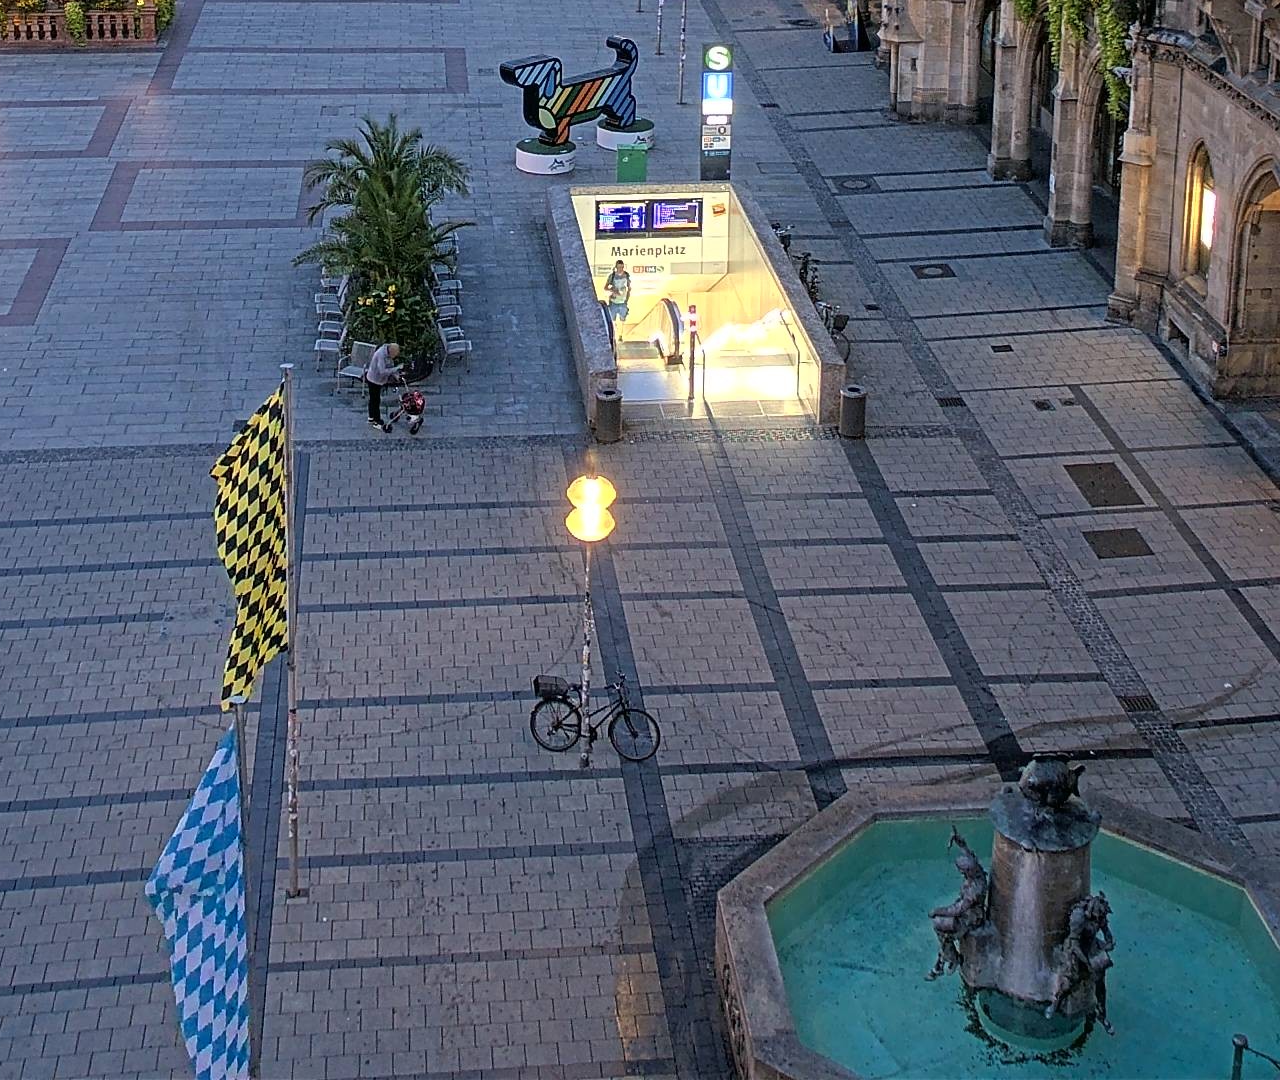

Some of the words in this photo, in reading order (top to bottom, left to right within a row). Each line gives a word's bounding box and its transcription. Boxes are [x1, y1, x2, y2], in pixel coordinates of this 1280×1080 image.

[708, 46, 730, 70] S
[707, 74, 728, 99] U
[611, 244, 686, 258] Marienplatz
